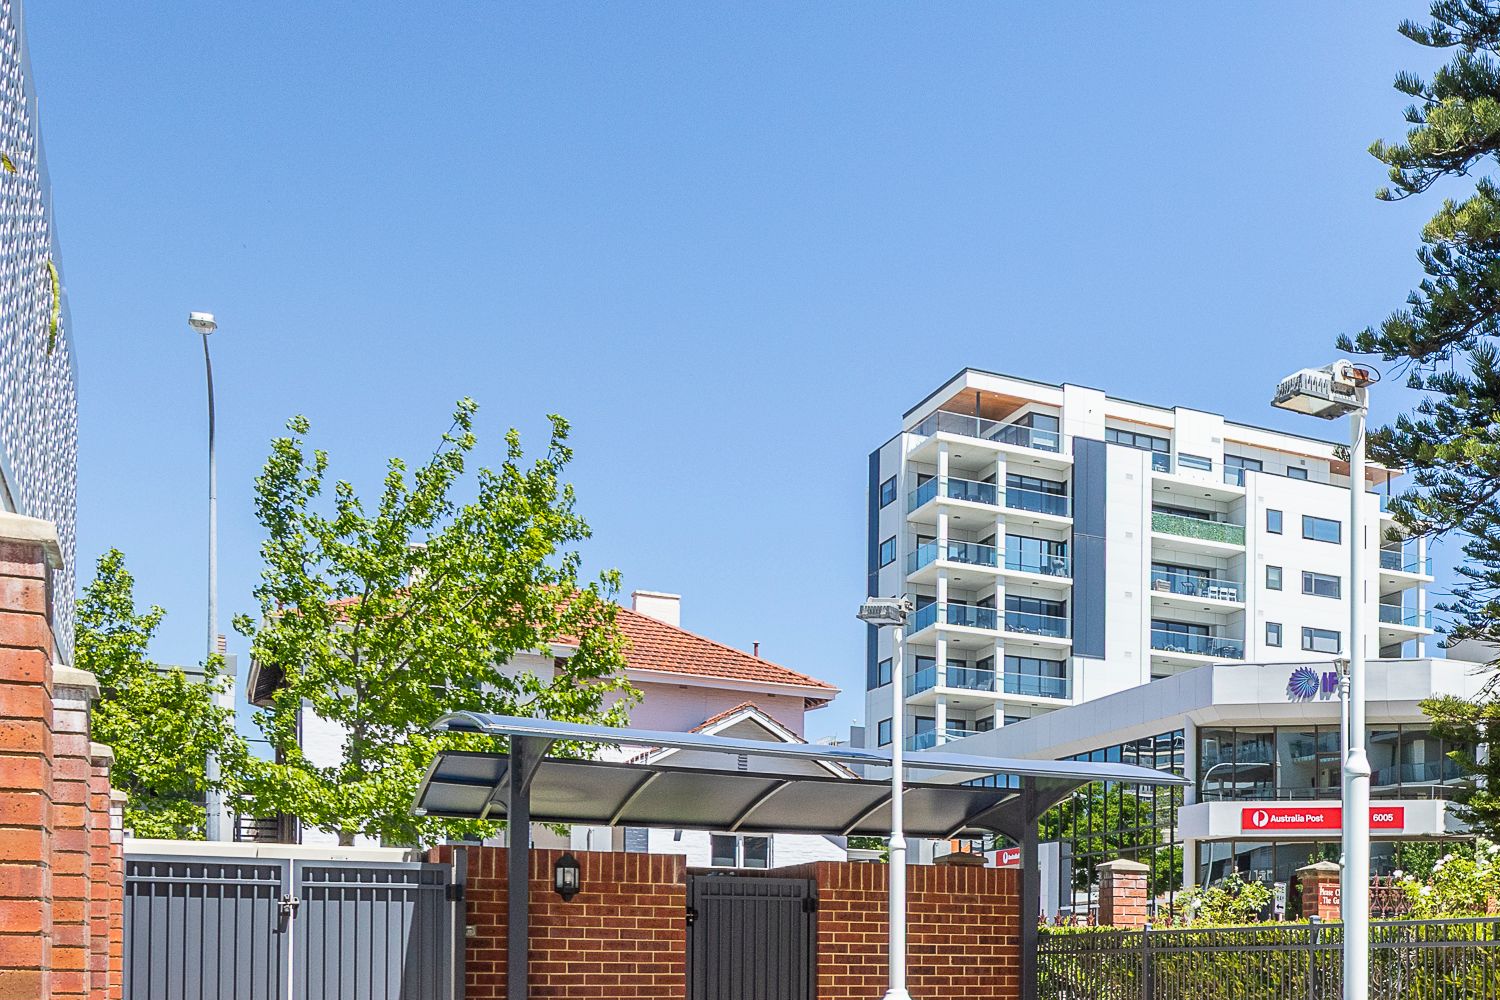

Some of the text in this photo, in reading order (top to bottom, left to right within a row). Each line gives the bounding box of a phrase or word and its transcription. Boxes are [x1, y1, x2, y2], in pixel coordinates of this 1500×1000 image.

[1270, 813, 1394, 823] Australia Post 6005
